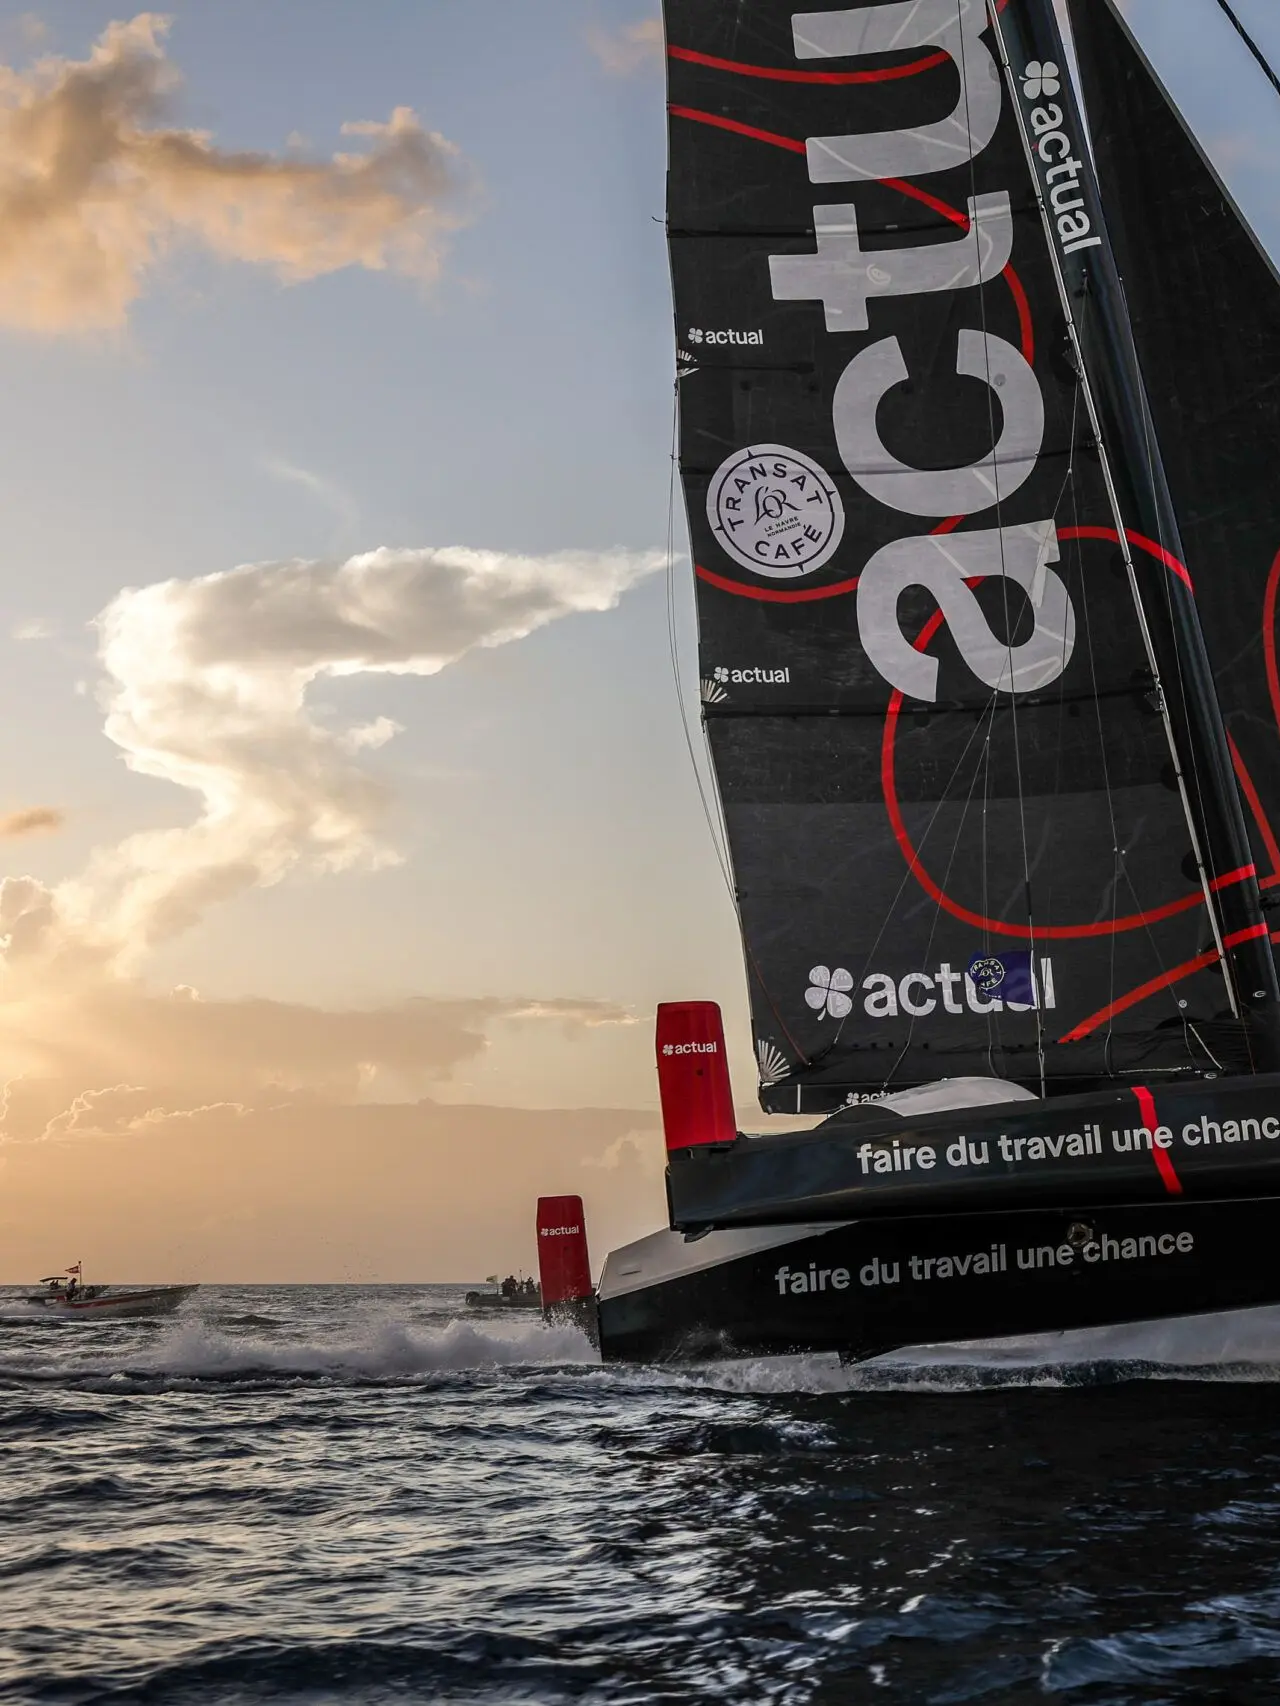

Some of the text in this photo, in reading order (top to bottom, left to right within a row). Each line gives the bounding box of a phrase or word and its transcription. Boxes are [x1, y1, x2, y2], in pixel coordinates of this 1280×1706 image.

[1030, 103, 1102, 254] actual
[705, 328, 764, 345] actual
[726, 463, 823, 532] TRANSAT
[767, 522, 801, 538] NORMANDIE
[775, 516, 799, 528] HAVRE
[755, 523, 823, 560] CAFÉ
[731, 667, 790, 683] actual
[862, 957, 1056, 1018] actul
[675, 1041, 718, 1055] actual
[857, 1140, 937, 1174] faire
[946, 1136, 990, 1167] du
[997, 1124, 1103, 1162] travail
[1112, 1125, 1173, 1152] une
[549, 1225, 580, 1236] actual
[775, 1231, 1194, 1295] faire du travail une chance
